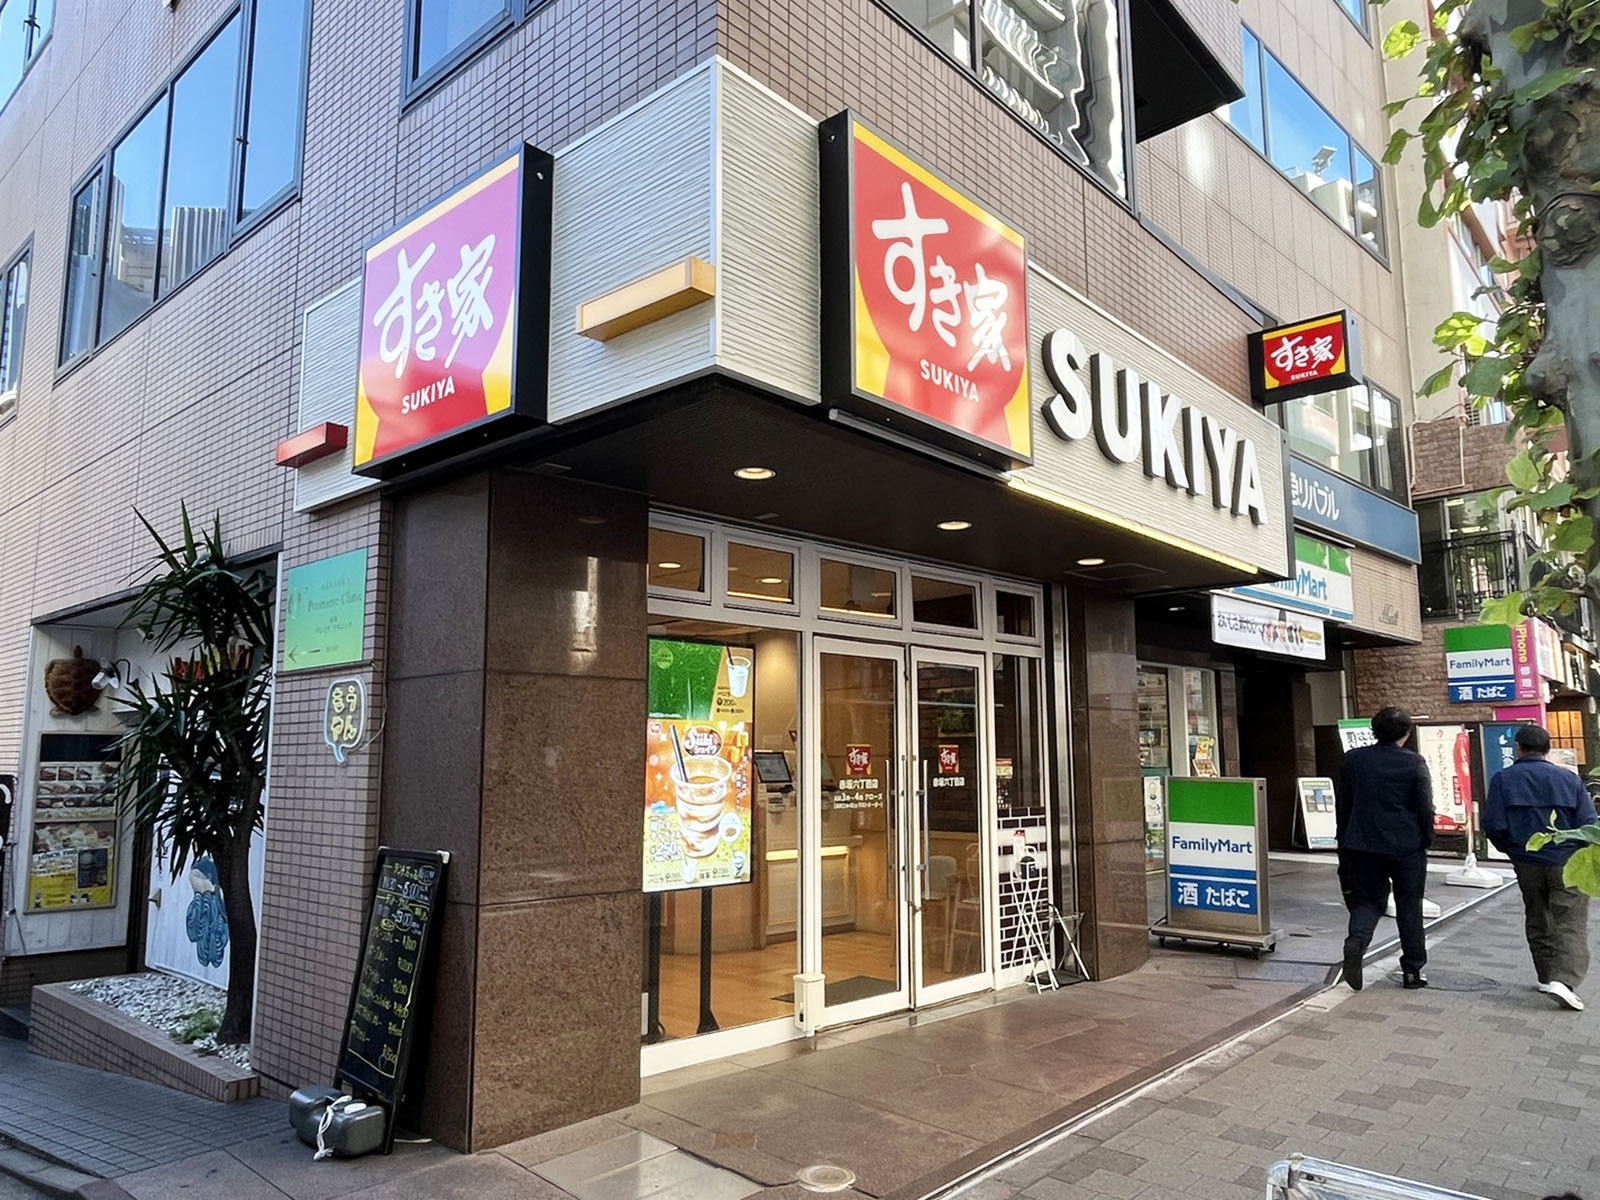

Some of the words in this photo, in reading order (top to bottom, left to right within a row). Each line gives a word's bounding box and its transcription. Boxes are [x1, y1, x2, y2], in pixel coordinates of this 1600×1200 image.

[872, 181, 1011, 372] すき家
[373, 234, 496, 379] すき家
[1270, 335, 1335, 372] すき家
[920, 359, 979, 402] SUKIYA
[1290, 370, 1318, 381] SUKIYA
[401, 376, 455, 414] SUKIYA
[1041, 327, 1268, 525] SUKIYA
[1449, 657, 1511, 669] FamilyMart
[1477, 685, 1508, 699] たばこ
[1172, 835, 1253, 854] FamilyMart
[1177, 881, 1199, 906] 酒
[1205, 886, 1251, 909] たばこ
